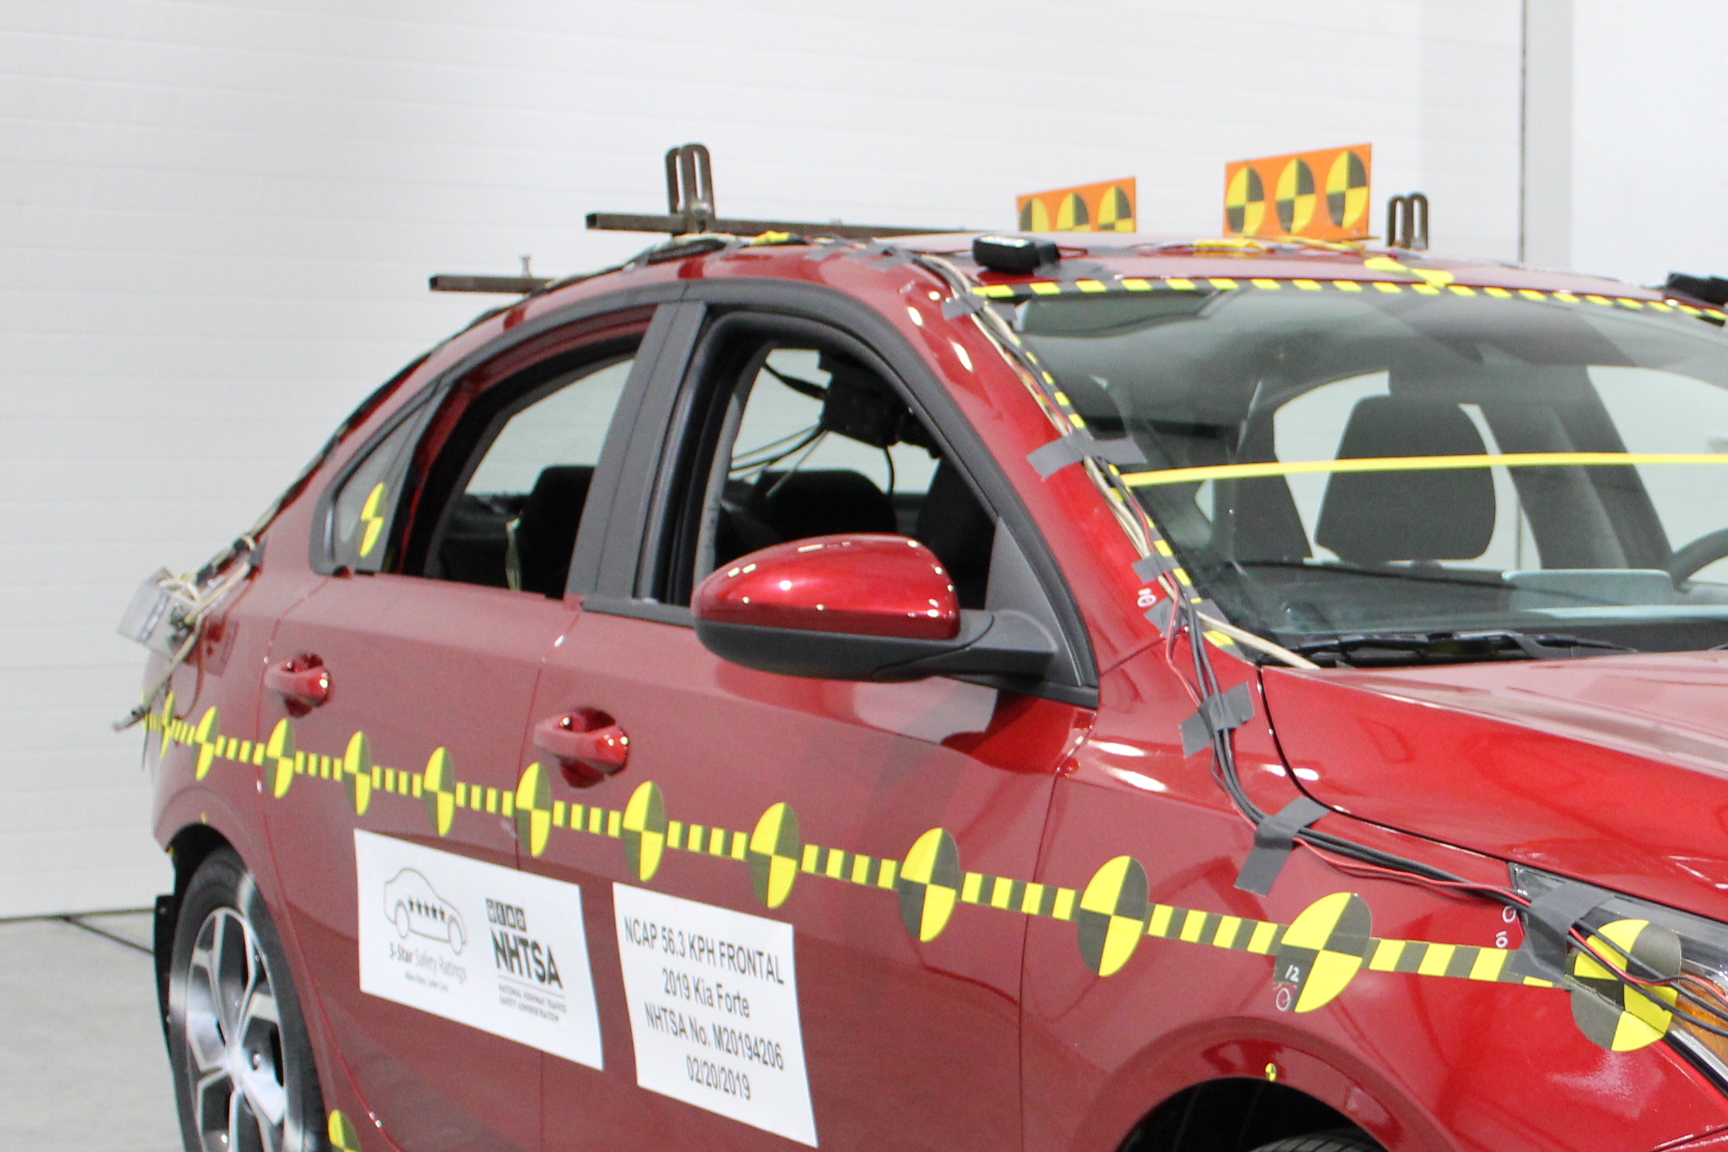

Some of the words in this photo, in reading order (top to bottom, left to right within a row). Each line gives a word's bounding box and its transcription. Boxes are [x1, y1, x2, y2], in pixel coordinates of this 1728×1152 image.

[490, 926, 563, 989] NHTSA
[624, 915, 657, 949] NCAP
[661, 925, 686, 958] 56.3
[688, 932, 716, 967] KPH
[718, 940, 785, 985] FRONTAL
[662, 967, 690, 1000] 2019
[692, 975, 714, 1008] Kia
[715, 982, 750, 1018] Forte
[644, 1001, 688, 1040] NHTSA
[688, 1015, 711, 1048] No.
[712, 1022, 785, 1071] M20194206
[686, 1054, 751, 1101] 02/20/2019
